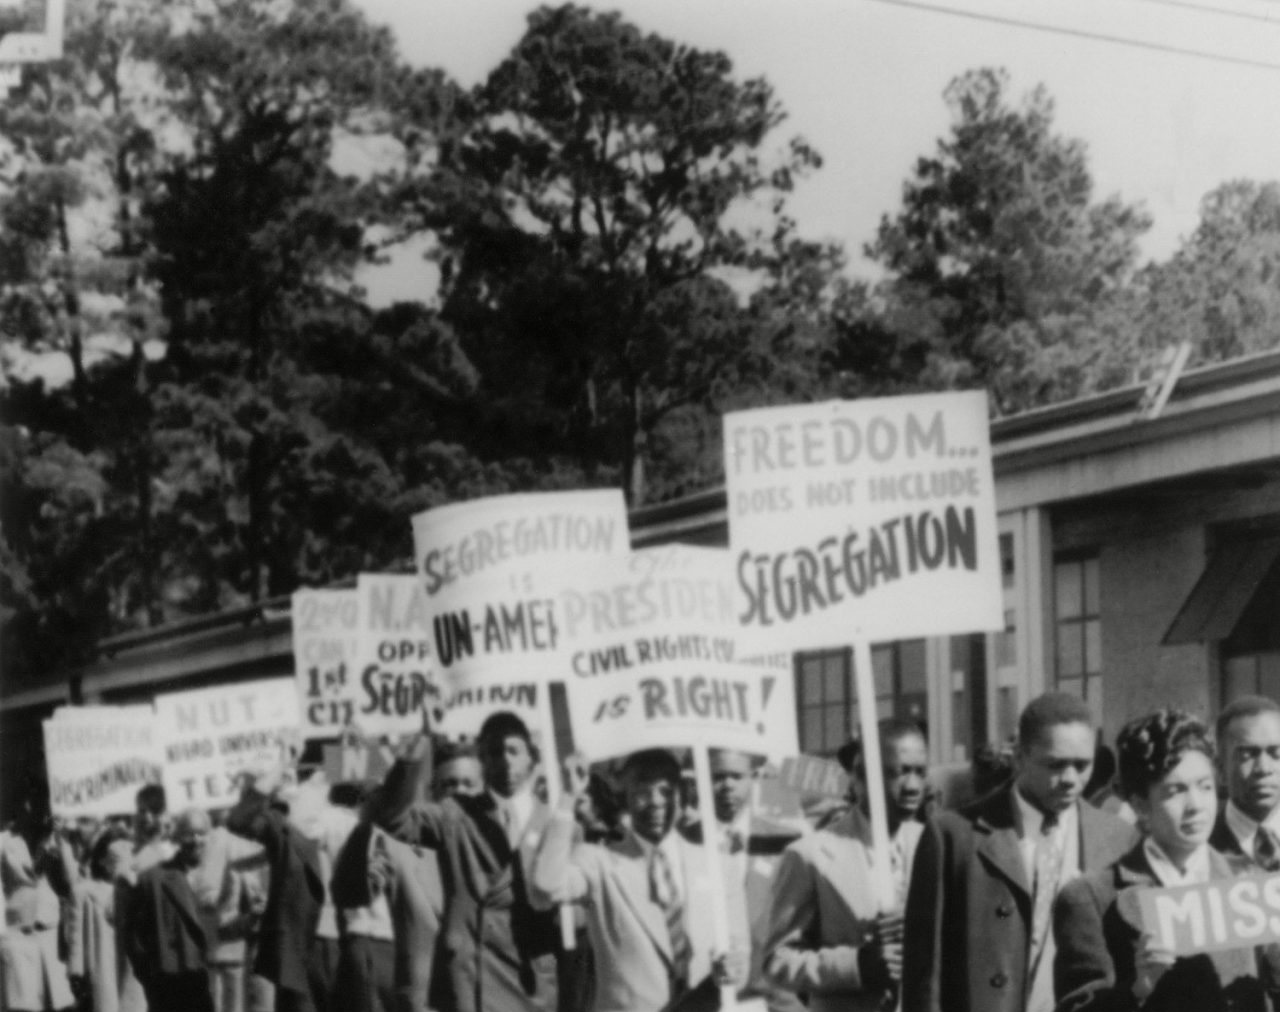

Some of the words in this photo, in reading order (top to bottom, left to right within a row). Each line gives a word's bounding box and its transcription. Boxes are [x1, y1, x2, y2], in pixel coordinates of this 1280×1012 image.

[736, 486, 794, 518] DOES
[806, 477, 856, 509] NOT
[868, 467, 981, 504] INCLUDE
[422, 512, 615, 599] SEGREGATION
[736, 504, 979, 627] SEGREGATION
[571, 644, 633, 678] CIVIL
[634, 634, 710, 665] RIGHTS
[175, 693, 257, 733] NUT
[637, 675, 776, 736] RIGHT!
